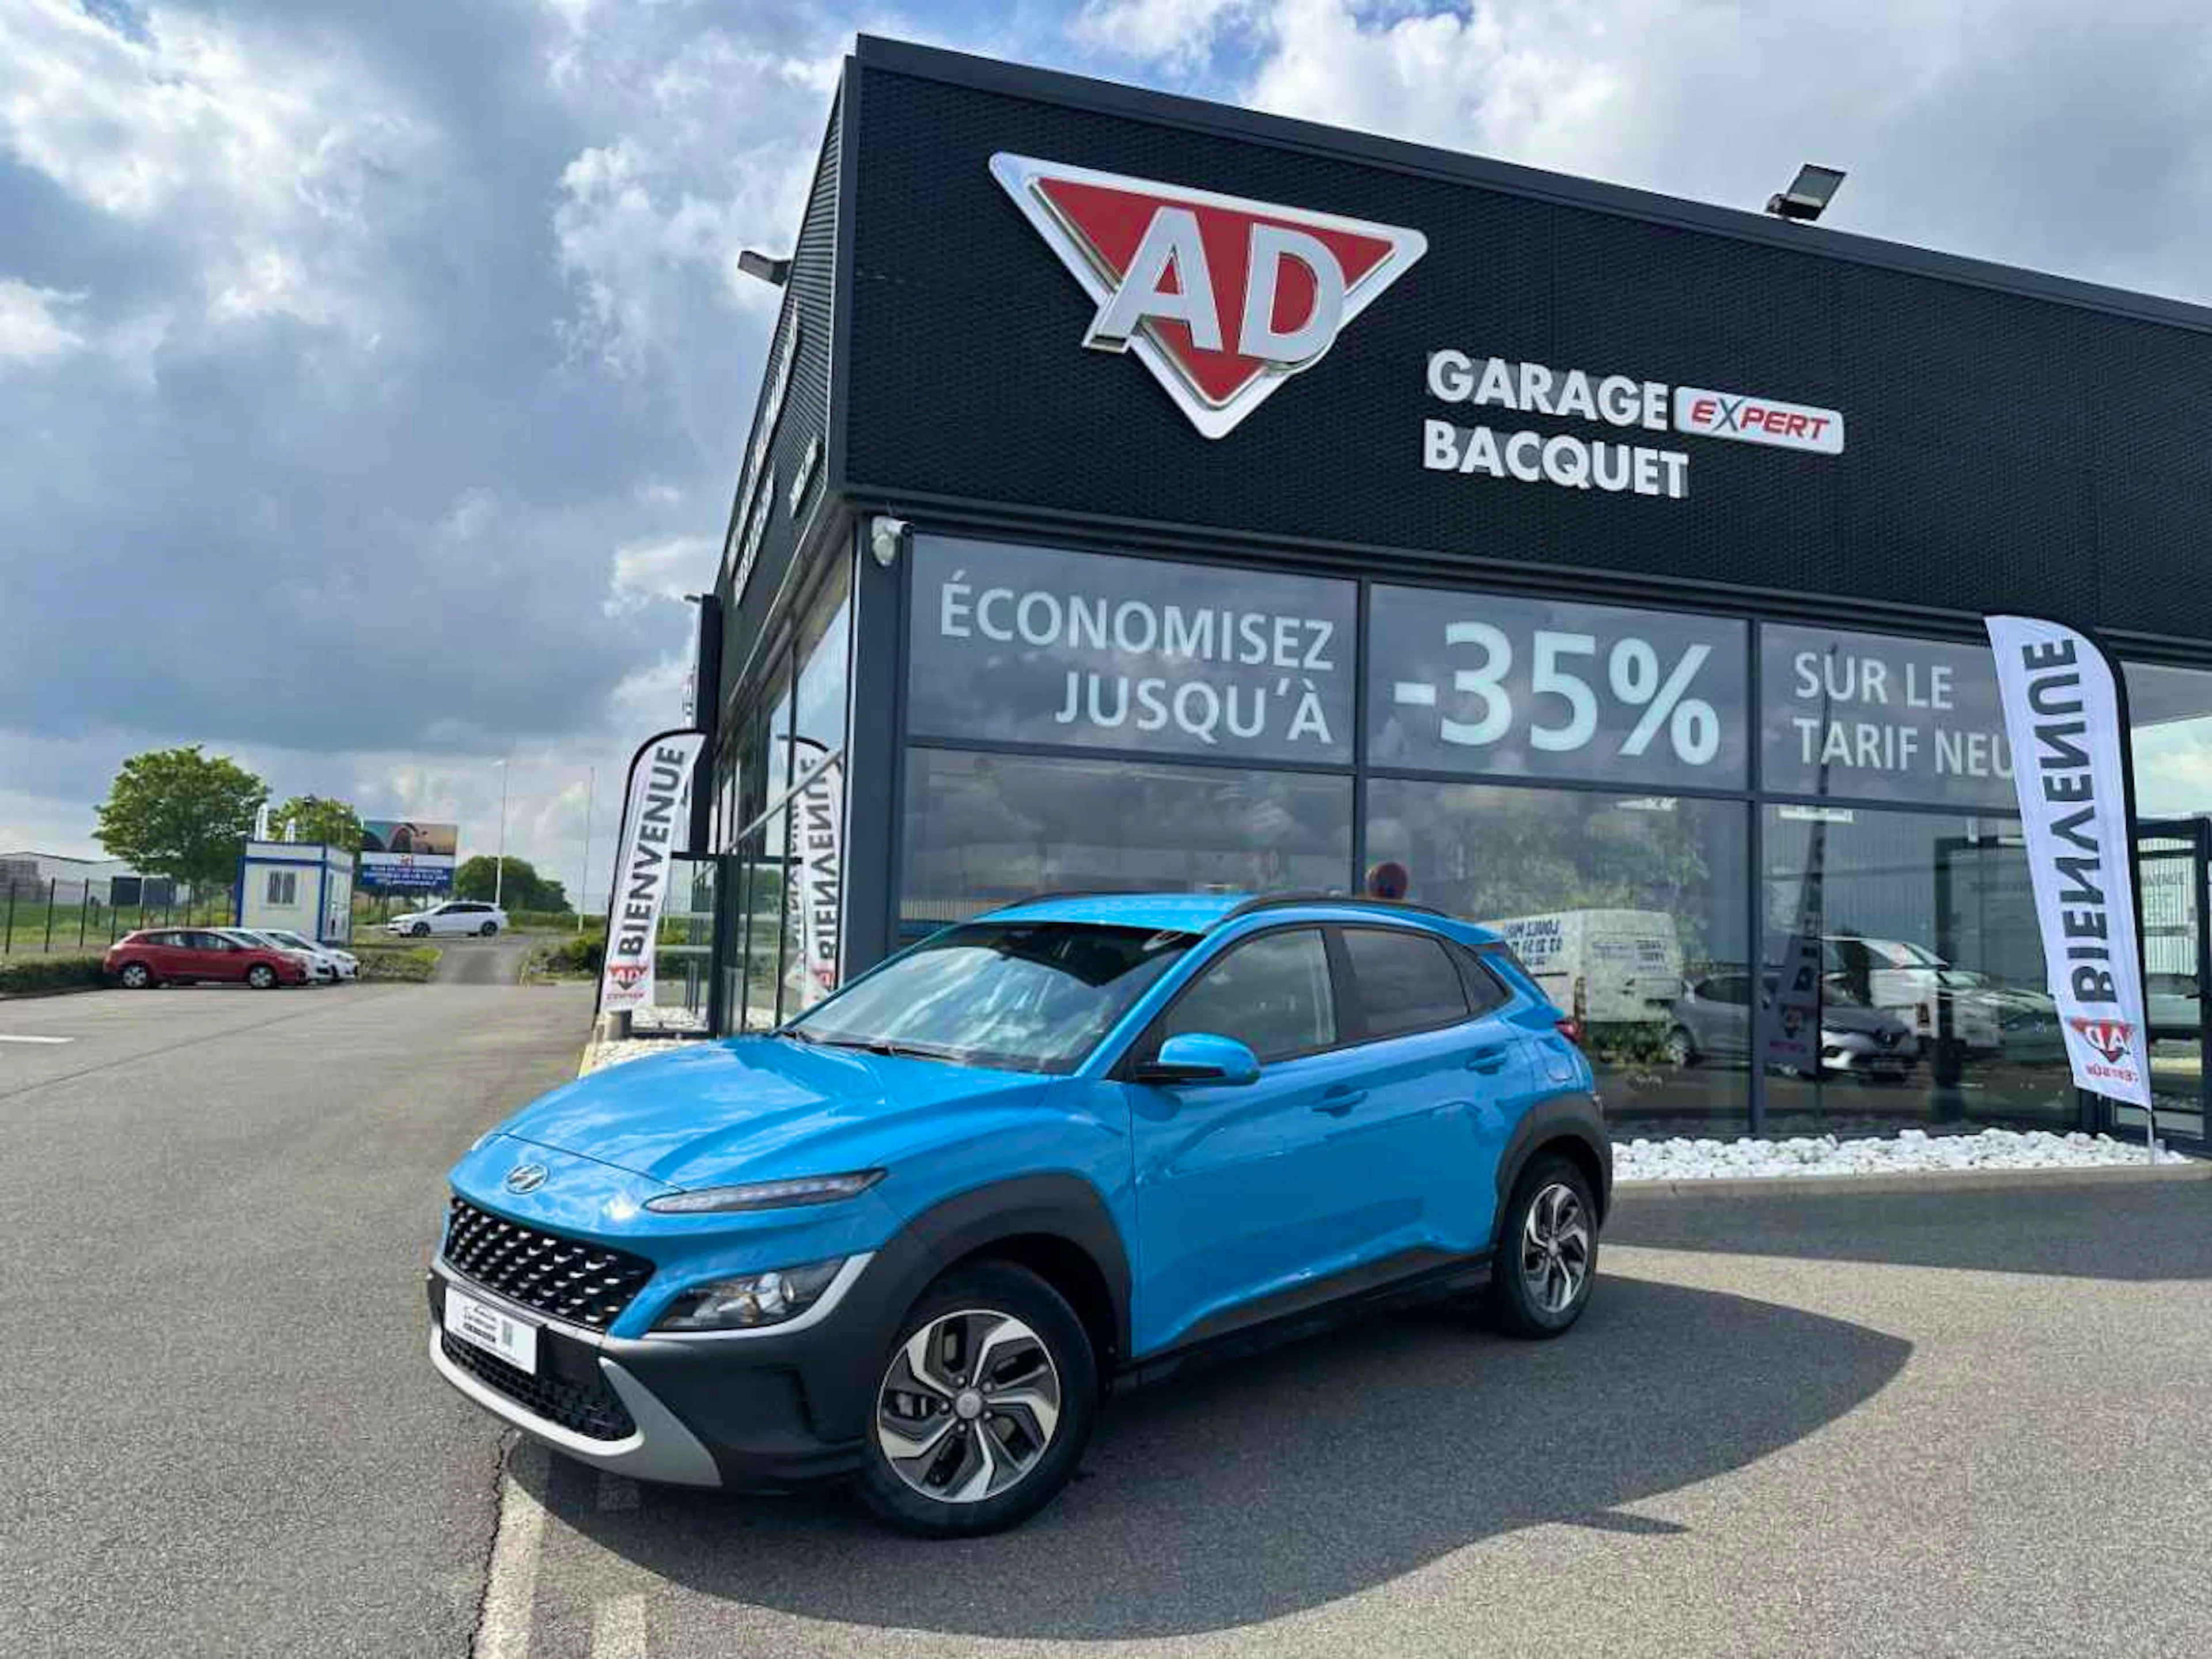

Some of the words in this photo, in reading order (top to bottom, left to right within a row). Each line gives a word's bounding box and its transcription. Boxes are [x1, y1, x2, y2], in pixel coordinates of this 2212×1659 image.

[1082, 204, 1347, 364] AD
[1426, 349, 1670, 431] GARAGE
[1691, 396, 1831, 440] EXPERT
[1423, 418, 1690, 499] BACQUET
[940, 569, 1335, 671] ÉCONOMISEZ
[1054, 671, 1332, 745] JUSQU'À
[1393, 620, 1719, 766] -35%
[1793, 650, 1889, 704] SUR
[1906, 662, 1953, 710] LE
[1793, 716, 1918, 771] TARIF
[1934, 729, 2014, 778] NEU
[618, 745, 685, 956] BIENVENUE
